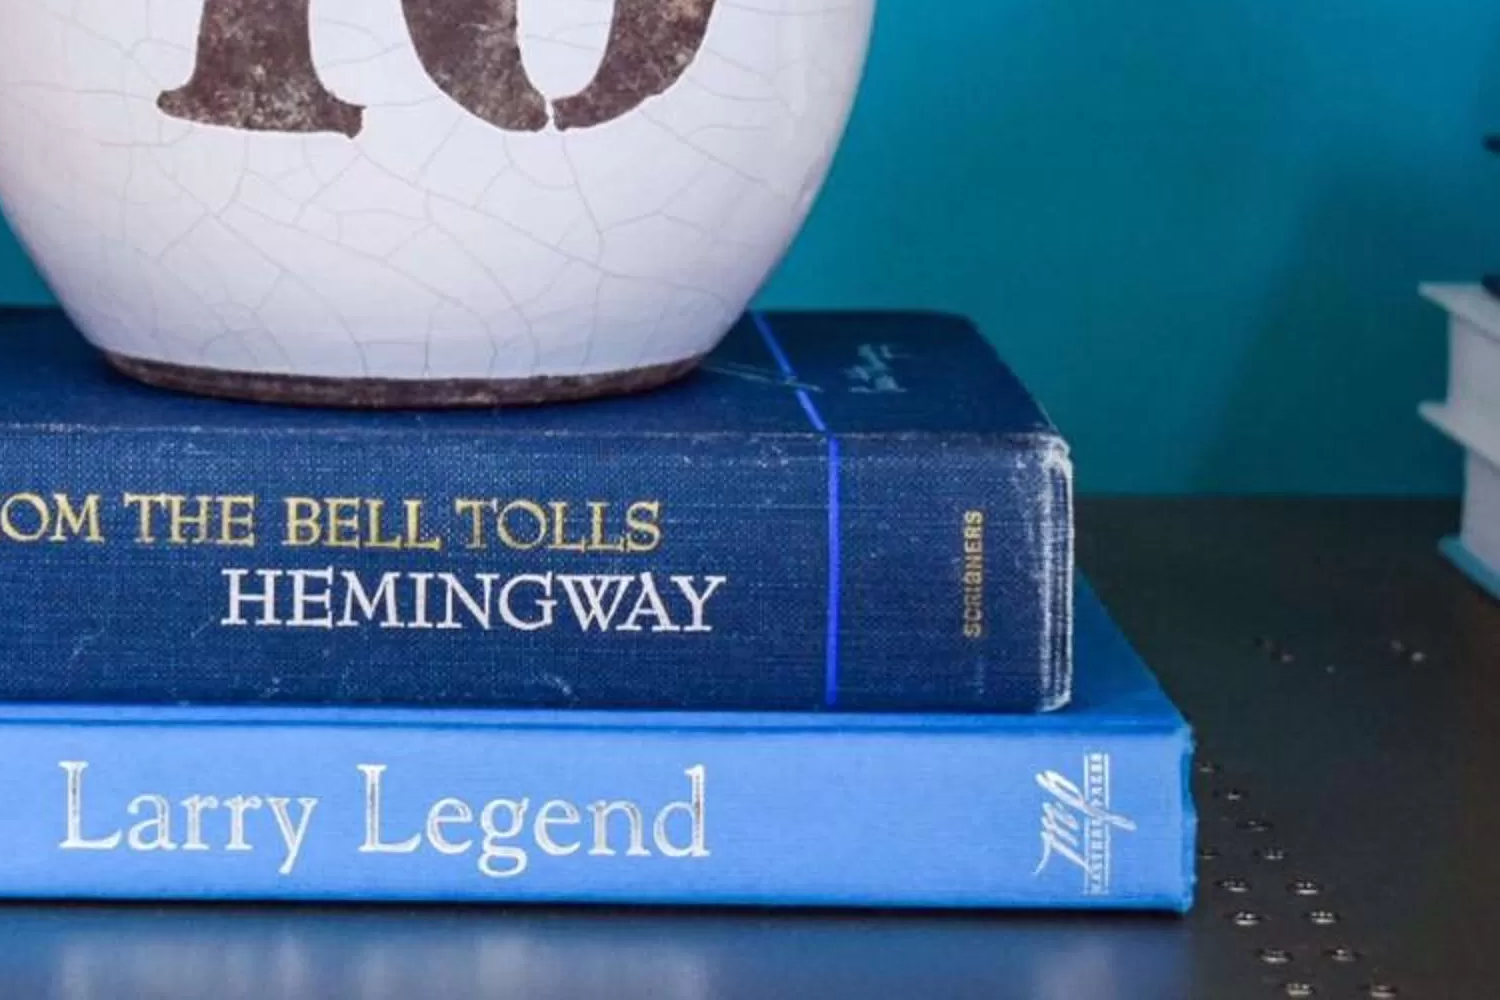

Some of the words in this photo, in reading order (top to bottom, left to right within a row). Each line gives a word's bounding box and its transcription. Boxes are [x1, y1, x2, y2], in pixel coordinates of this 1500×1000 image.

[123, 491, 255, 548] THE
[281, 496, 442, 551] BELL
[454, 497, 661, 553] TOLLS
[220, 565, 727, 633] HEMINGWAY
[57, 760, 318, 875] Larry
[355, 763, 711, 878] Legend
